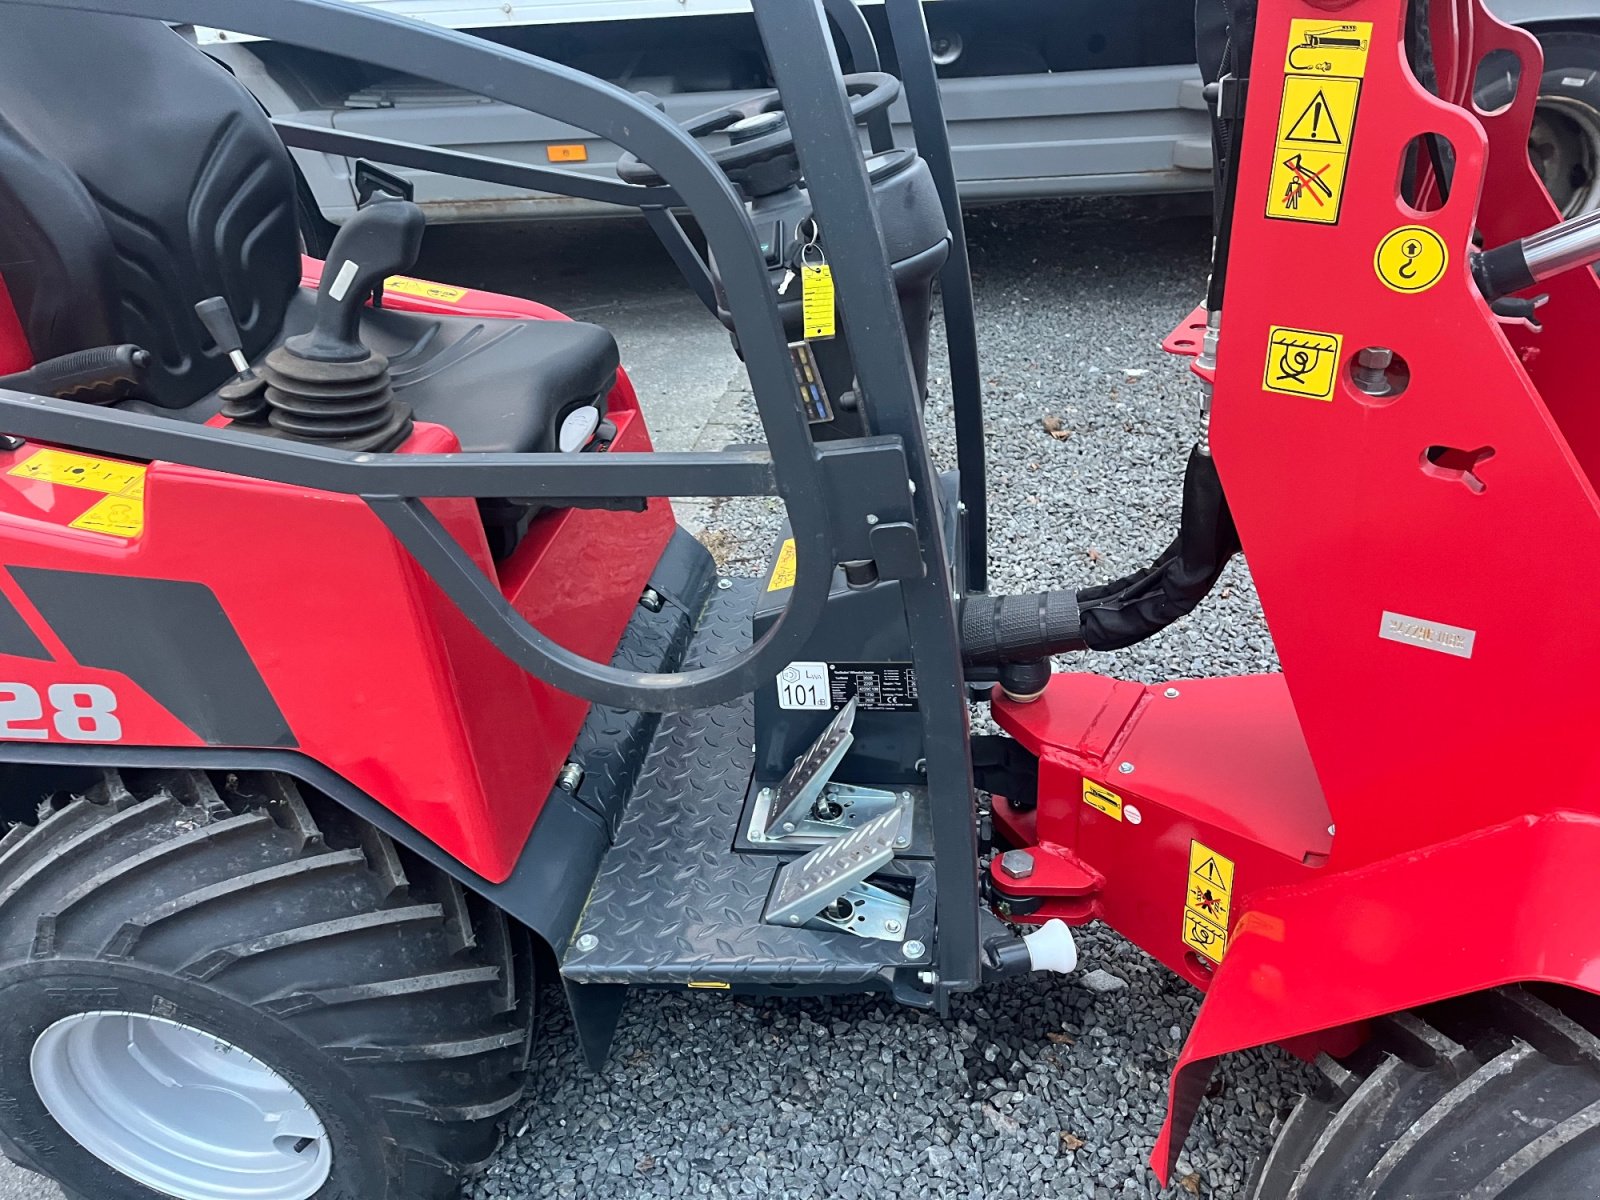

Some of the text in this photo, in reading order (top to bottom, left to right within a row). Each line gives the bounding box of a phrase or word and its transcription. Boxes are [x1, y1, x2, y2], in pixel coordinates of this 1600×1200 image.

[0, 682, 122, 741] 28
[784, 684, 816, 706] 101
[817, 698, 826, 706] dB
